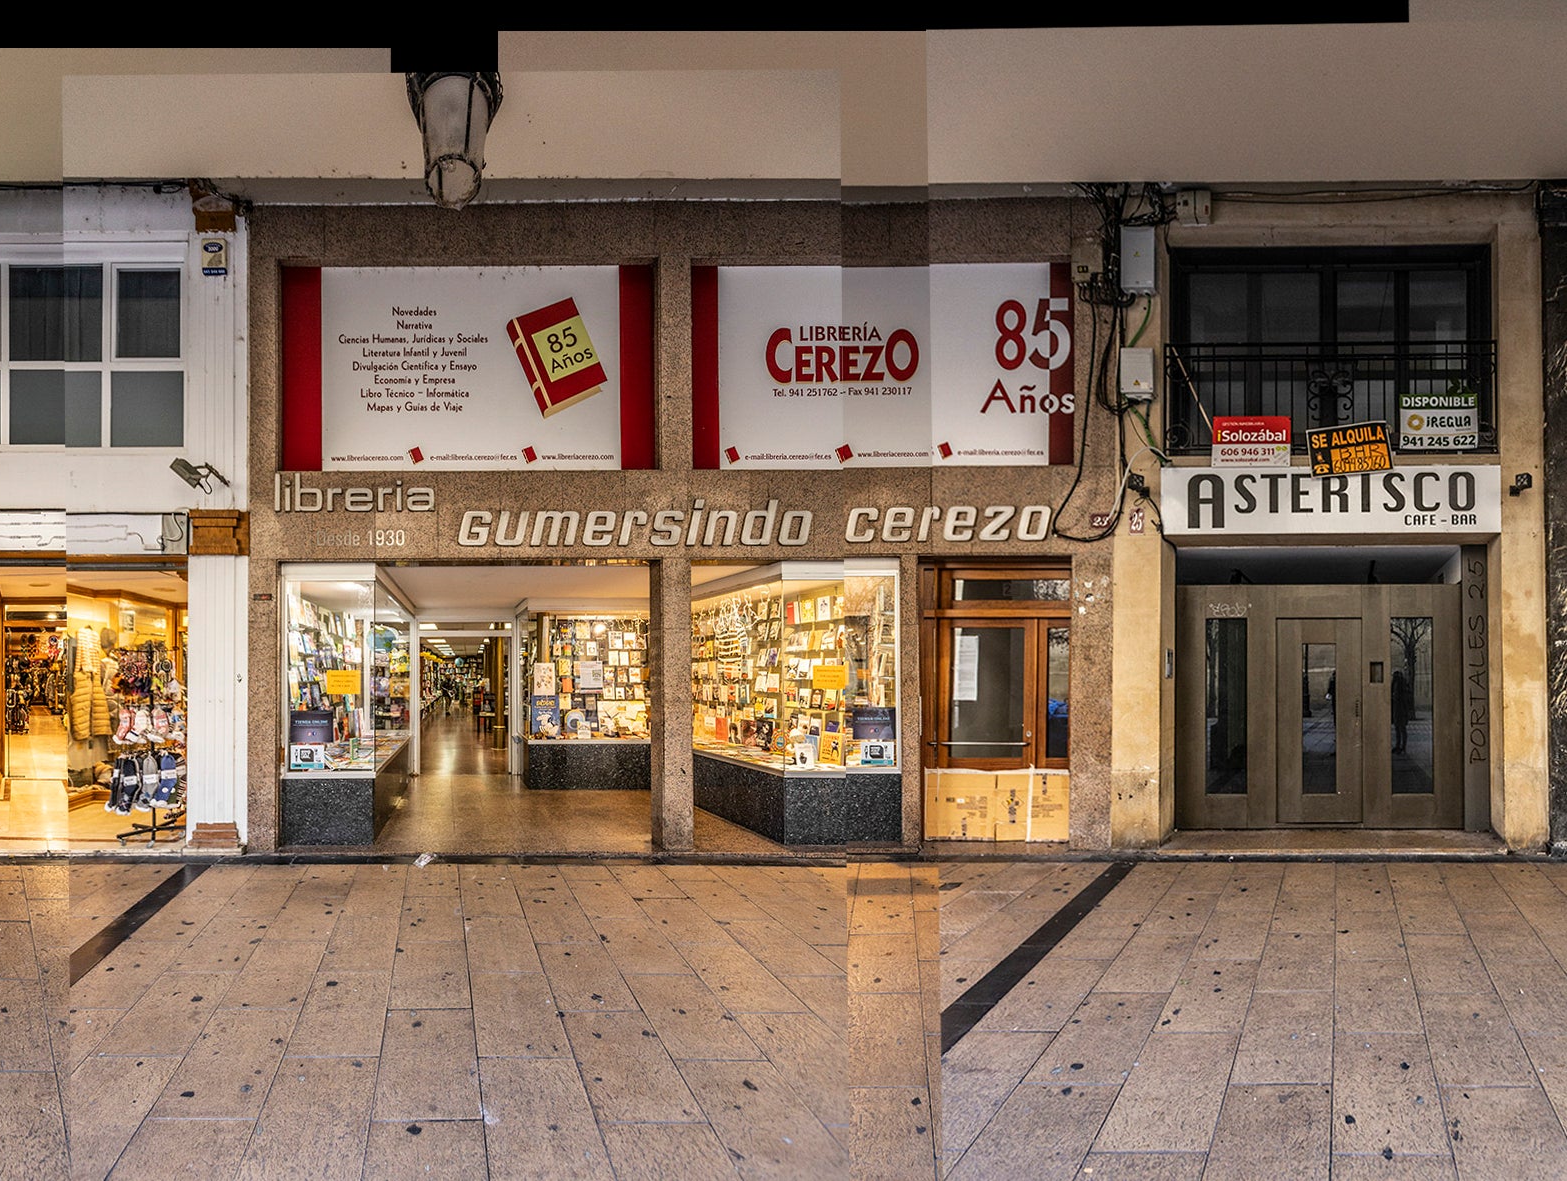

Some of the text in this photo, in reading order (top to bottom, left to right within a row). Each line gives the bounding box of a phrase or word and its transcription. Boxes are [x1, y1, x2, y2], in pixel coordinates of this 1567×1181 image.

[392, 306, 437, 317] Novedades
[396, 320, 433, 330] Narrativa
[338, 333, 488, 344] Ciencias Humanas, Jurídicas y Sociales
[546, 326, 578, 353] 85
[995, 297, 1072, 371] 85
[362, 347, 467, 357] Literatura Infantil y Juvenil
[765, 327, 919, 385] CEREZO
[352, 361, 477, 373] Divulgación Científica y Ensayo
[551, 348, 593, 373] Años
[374, 375, 456, 385] Economía y Empresa
[360, 388, 470, 398] Libro Técnico Informática
[772, 386, 912, 397] Tel. 941 251762 Fax 941 230117
[980, 378, 1076, 415] Años
[367, 402, 463, 413] Mapas y Guías de Viaje
[1402, 396, 1475, 407] DISPONIBLE
[1217, 429, 1286, 442] iSolozábal
[1311, 425, 1386, 449] SE ALQUILA
[1402, 434, 1476, 447] 941 245 622
[330, 454, 404, 462] www.libreriacerezo.com
[1220, 447, 1275, 456] 606 946 311
[274, 472, 435, 513] libreria
[1186, 471, 1477, 529] ASTERISCO
[844, 504, 1053, 543] cerezo
[1404, 513, 1477, 526] CAFE BAR
[316, 529, 406, 547] Desde 1930
[1467, 557, 1487, 765] PORTALES 25
